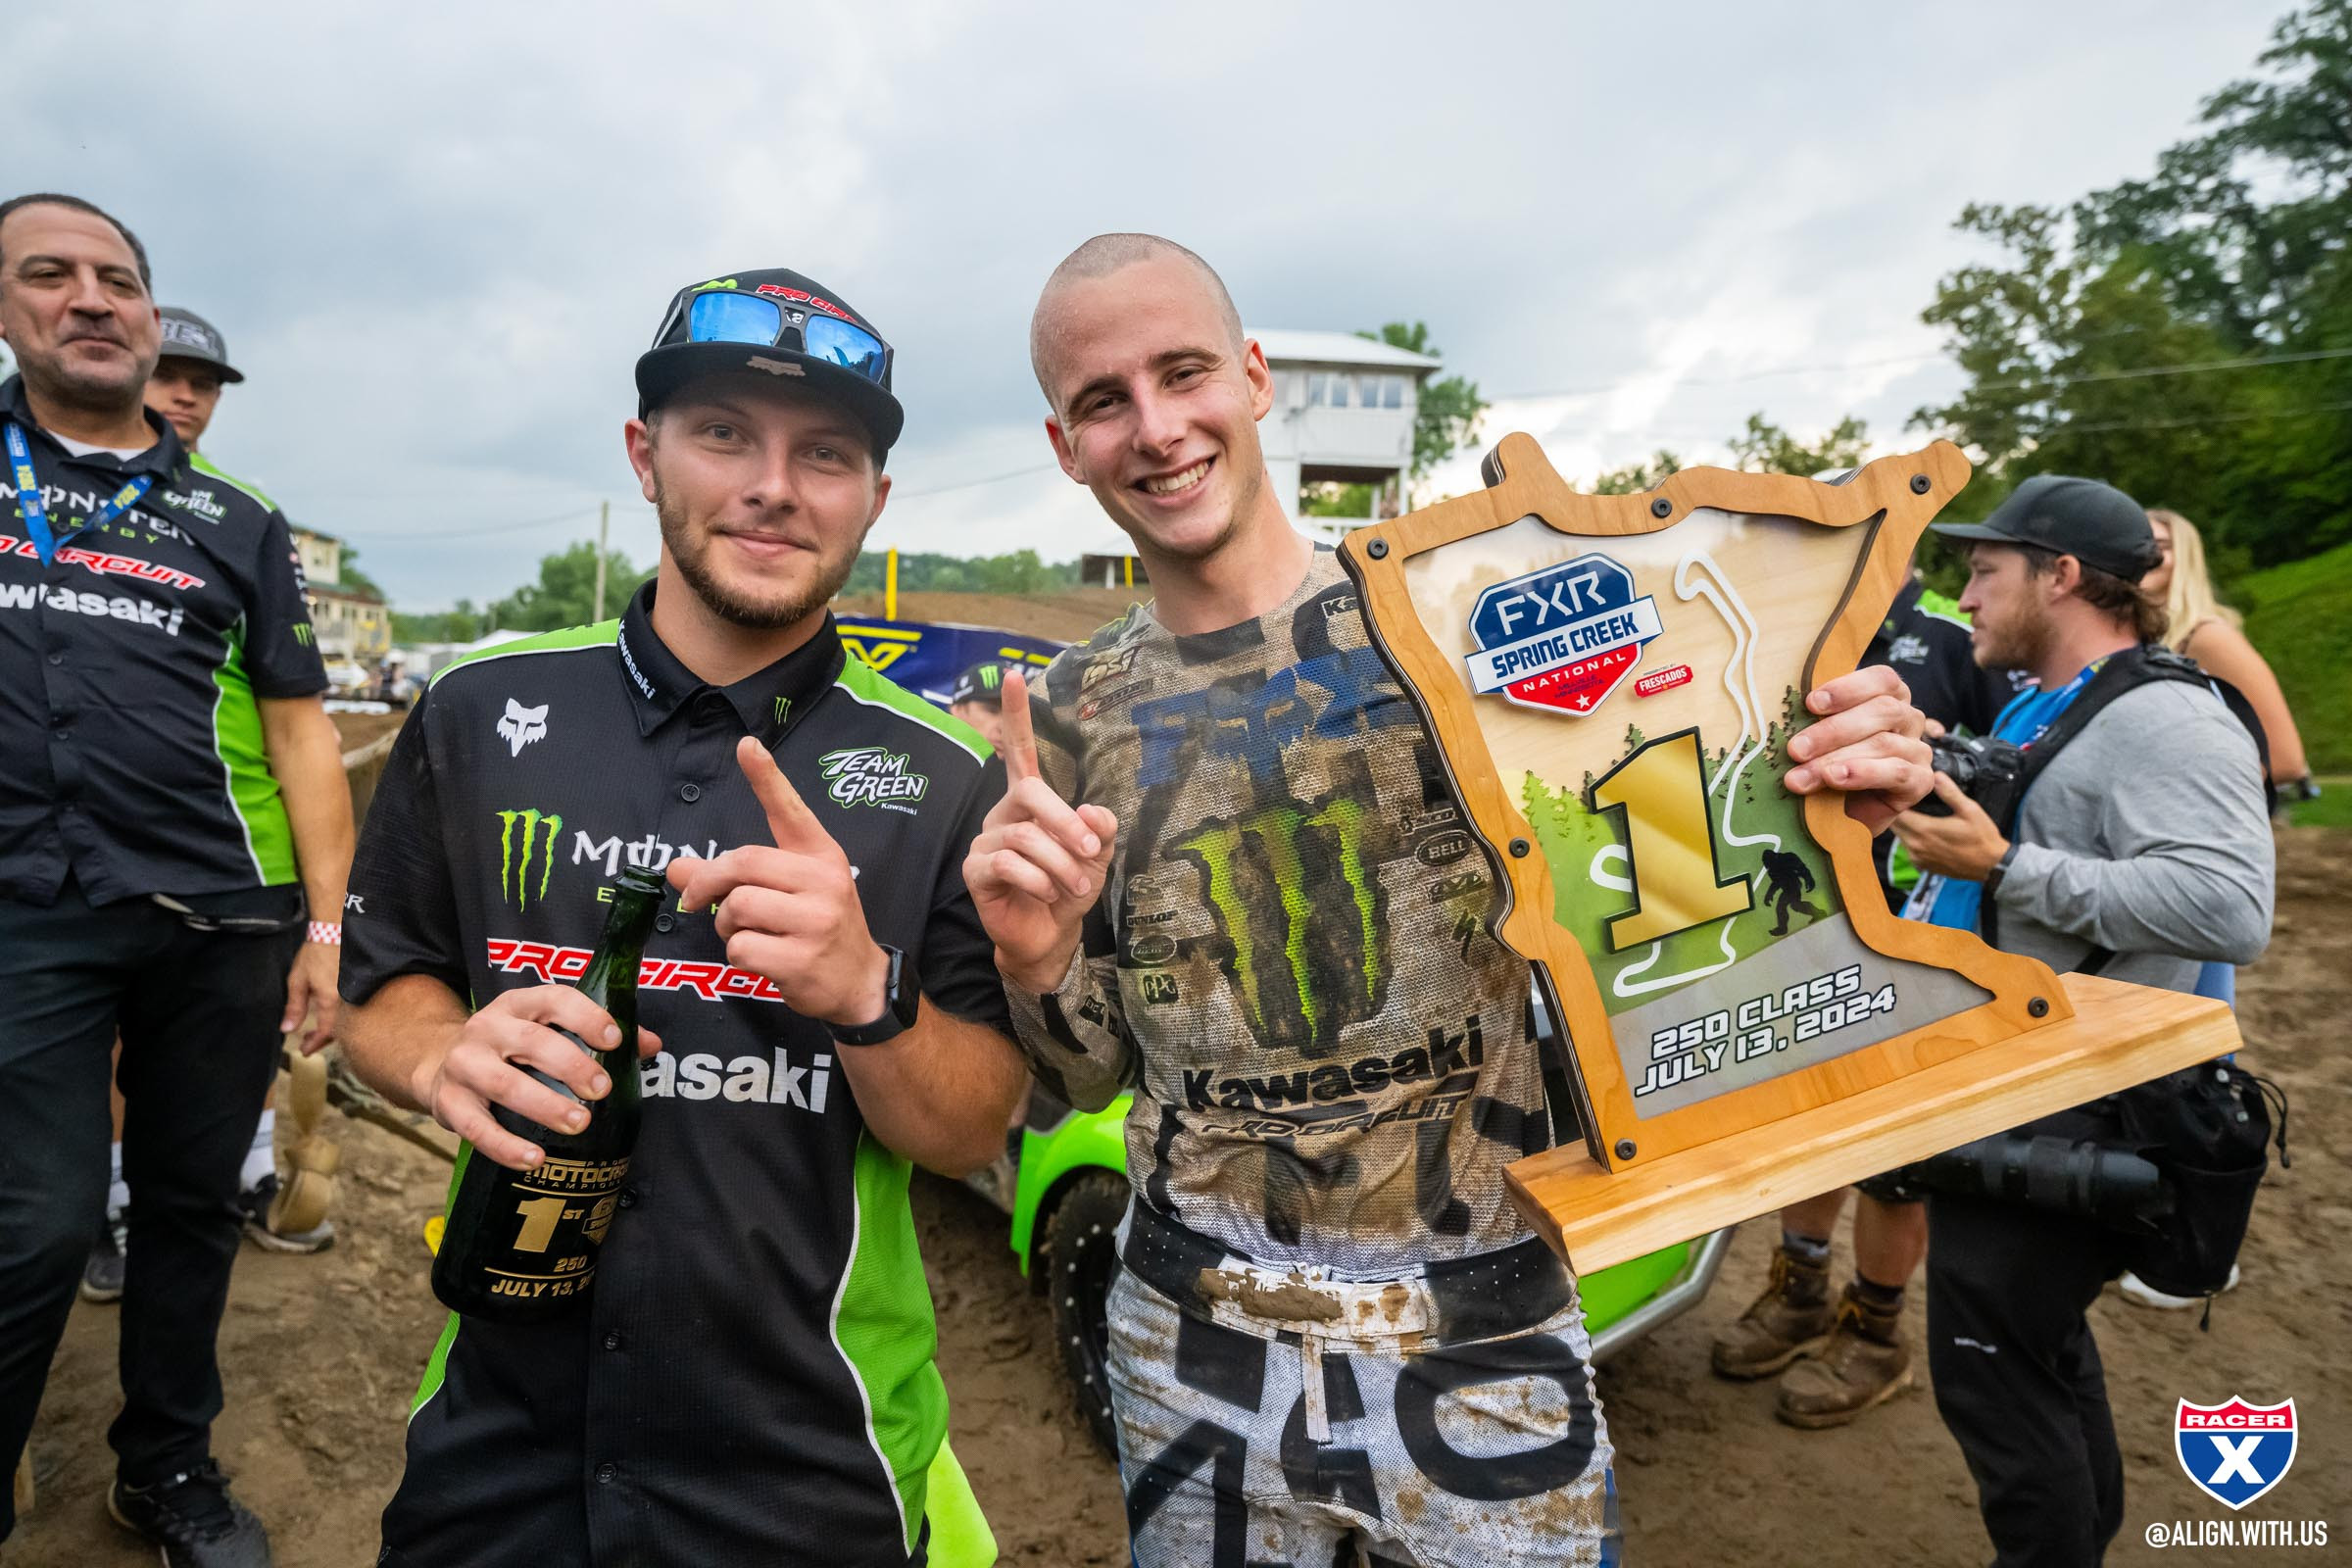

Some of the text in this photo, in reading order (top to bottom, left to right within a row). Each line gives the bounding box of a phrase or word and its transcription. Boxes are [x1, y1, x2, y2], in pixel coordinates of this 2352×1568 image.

[756, 283, 810, 302] PRO
[1495, 570, 1607, 637] FXR
[618, 619, 657, 700] Kawasaki
[1491, 611, 1640, 679] SPRING CREEK
[1522, 653, 1627, 693] NATIONAL
[1639, 667, 1688, 692] FRESCADOS
[822, 749, 906, 777] TEAM
[832, 771, 925, 804] GREEN
[880, 803, 918, 816] Kawasaki
[1428, 840, 1466, 859] BELL
[1588, 725, 1756, 955] 1
[486, 938, 596, 985] PRO
[1651, 963, 1862, 1060] 250 CLASS
[1634, 1042, 1730, 1098] JULY
[1794, 983, 1897, 1043] 2024
[641, 1046, 833, 1114] asaki
[1183, 1014, 1485, 1115] Kawasaki
[554, 1255, 588, 1273] 250
[492, 1278, 549, 1298] JULY
